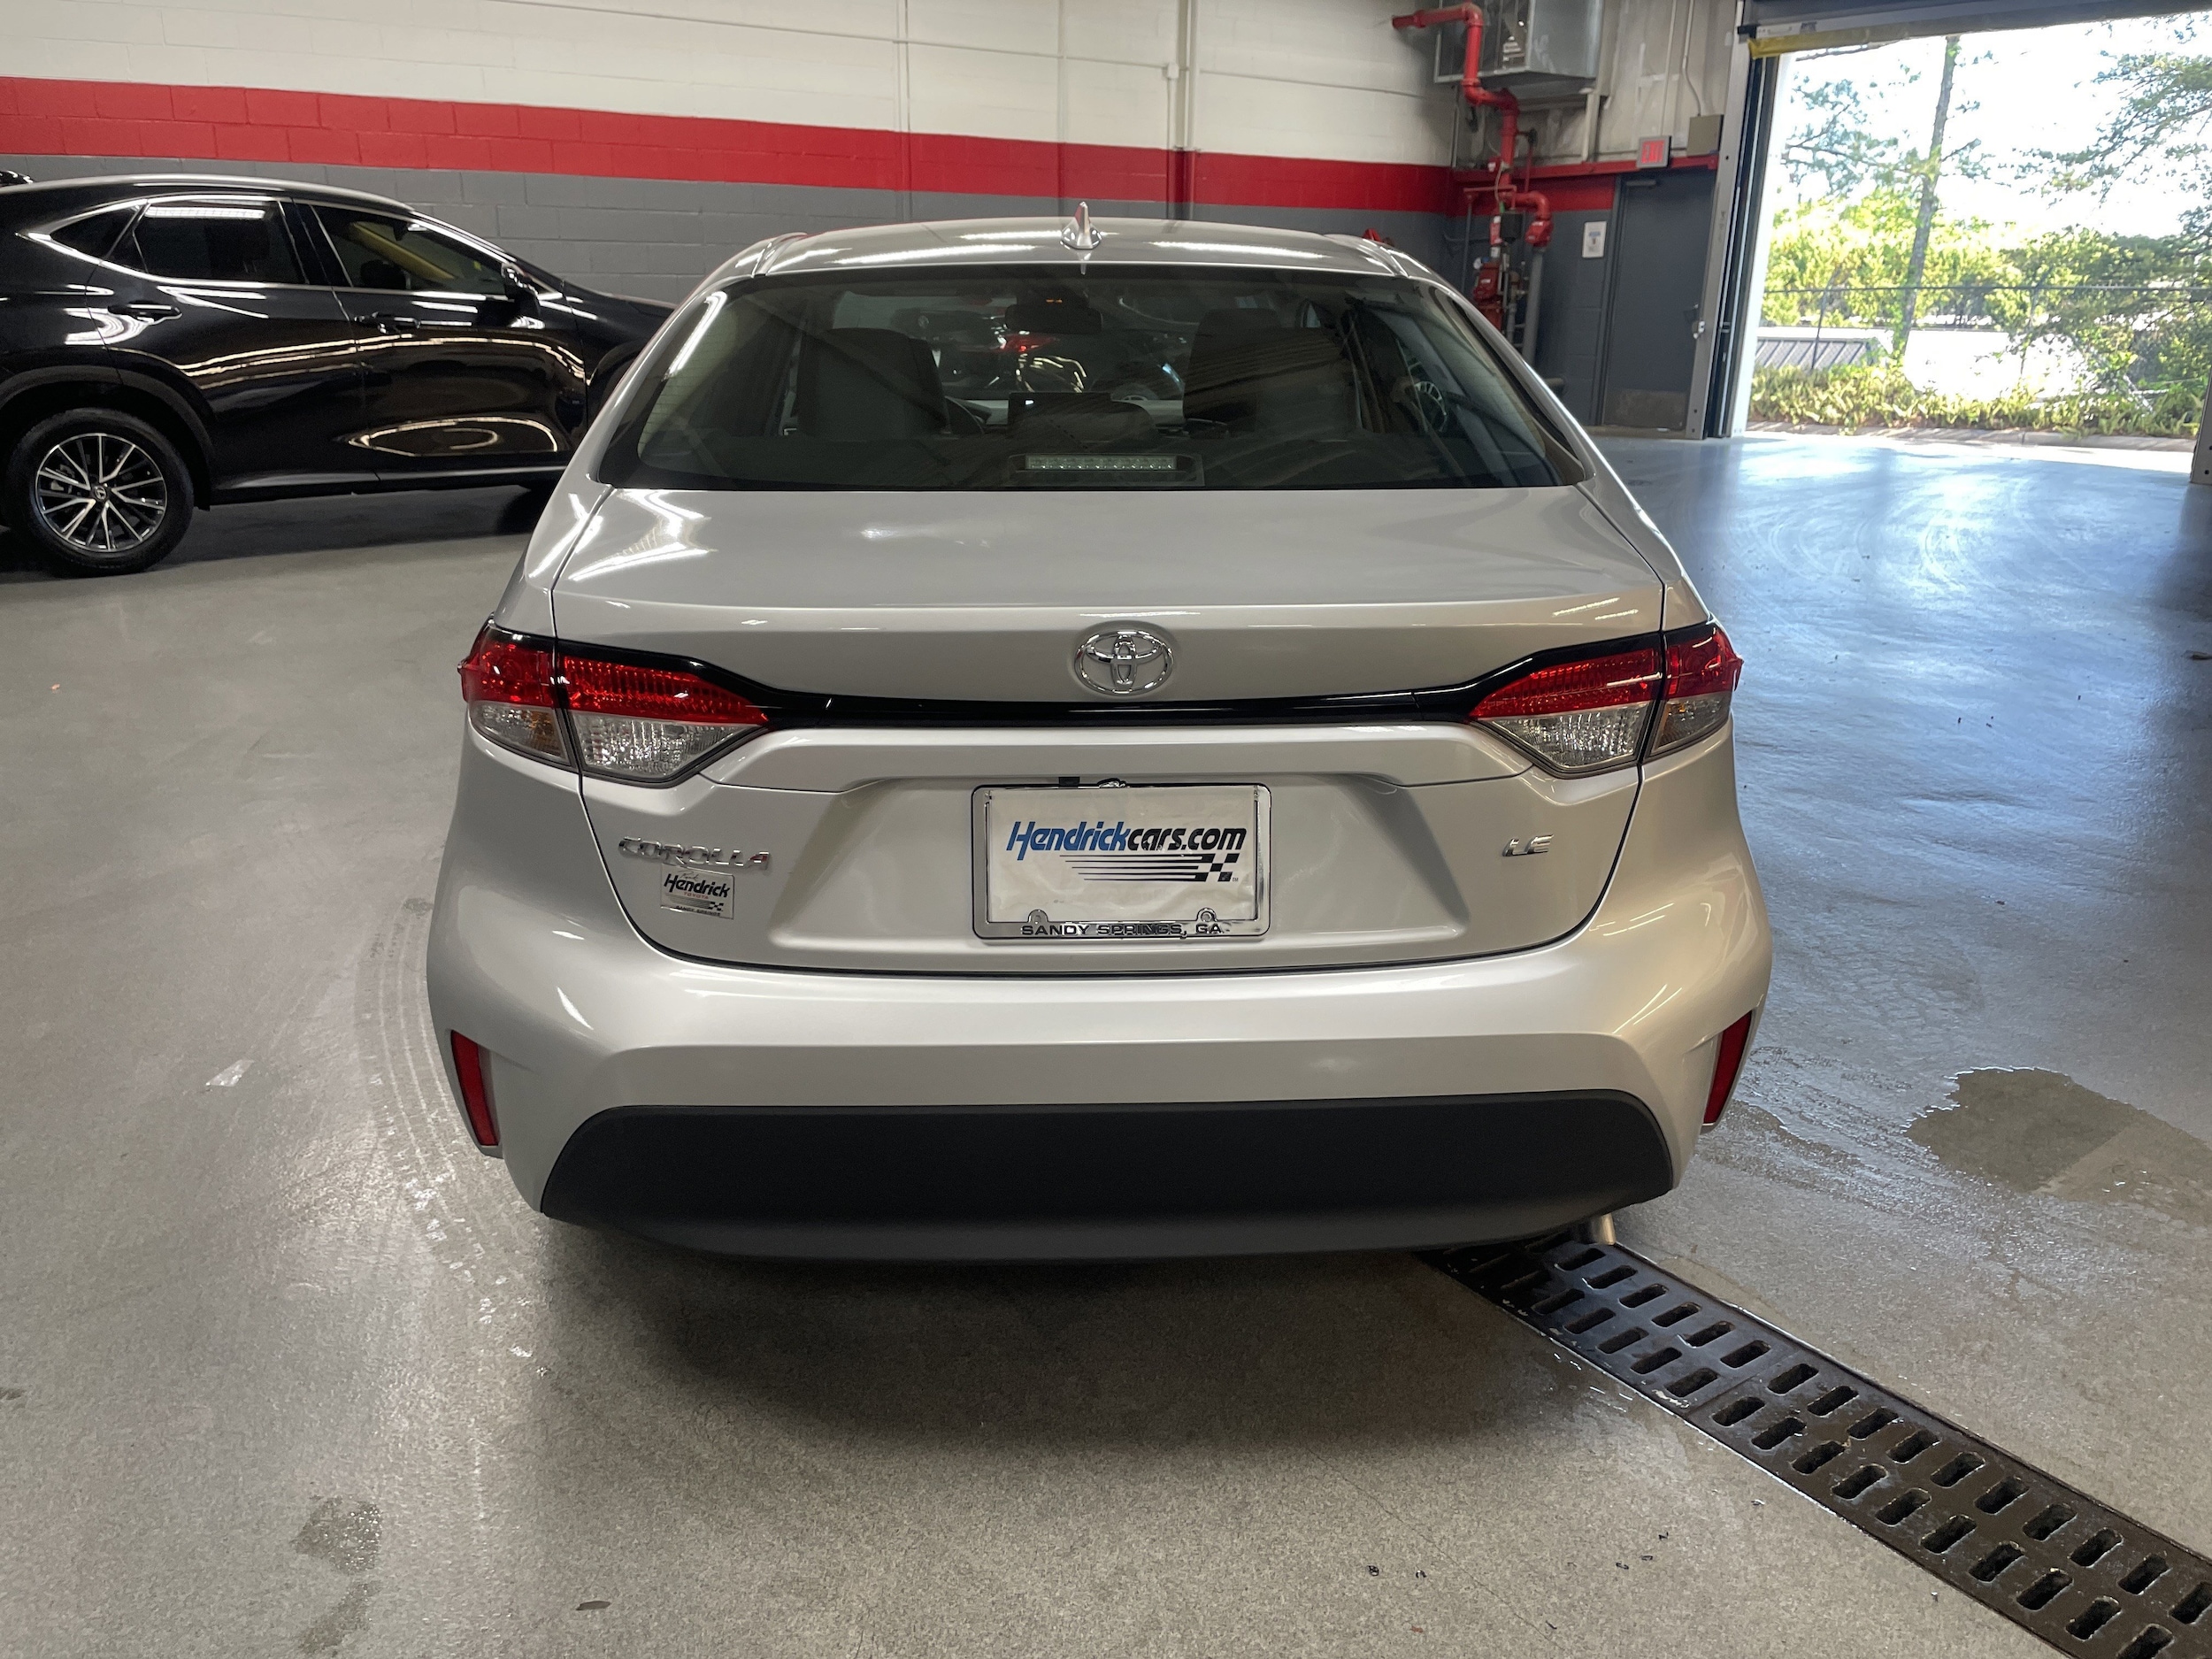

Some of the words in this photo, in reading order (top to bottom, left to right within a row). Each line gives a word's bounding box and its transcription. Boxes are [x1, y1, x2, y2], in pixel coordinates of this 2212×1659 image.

[1006, 821, 1247, 861] Hendrickcars.com
[1502, 833, 1554, 856] LE
[619, 836, 770, 870] COROLLA
[664, 873, 730, 897] Hendrick
[684, 891, 709, 900] TOYOTA
[1021, 924, 1089, 936] SANDY
